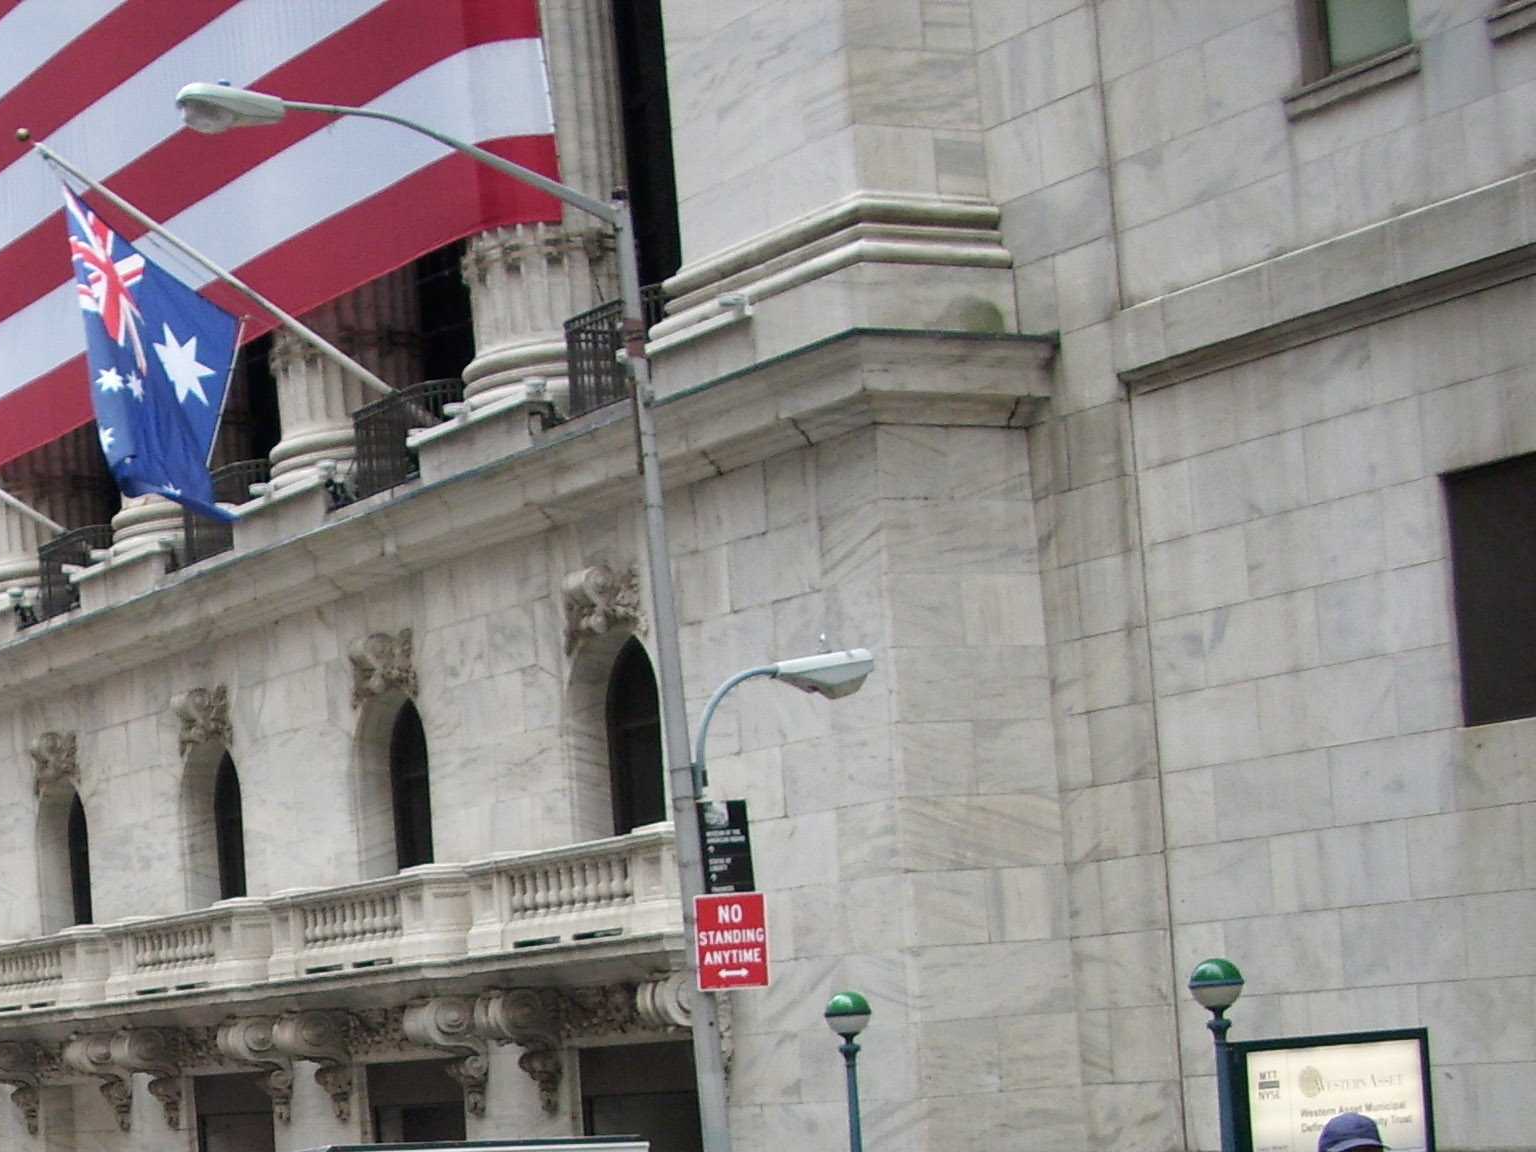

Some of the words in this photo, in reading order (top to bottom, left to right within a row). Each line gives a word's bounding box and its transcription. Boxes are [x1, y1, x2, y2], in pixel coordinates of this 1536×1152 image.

[718, 903, 743, 924] NO
[699, 927, 765, 946] STANDING
[704, 948, 762, 966] ANYTIME
[1301, 1107, 1337, 1118] Western
